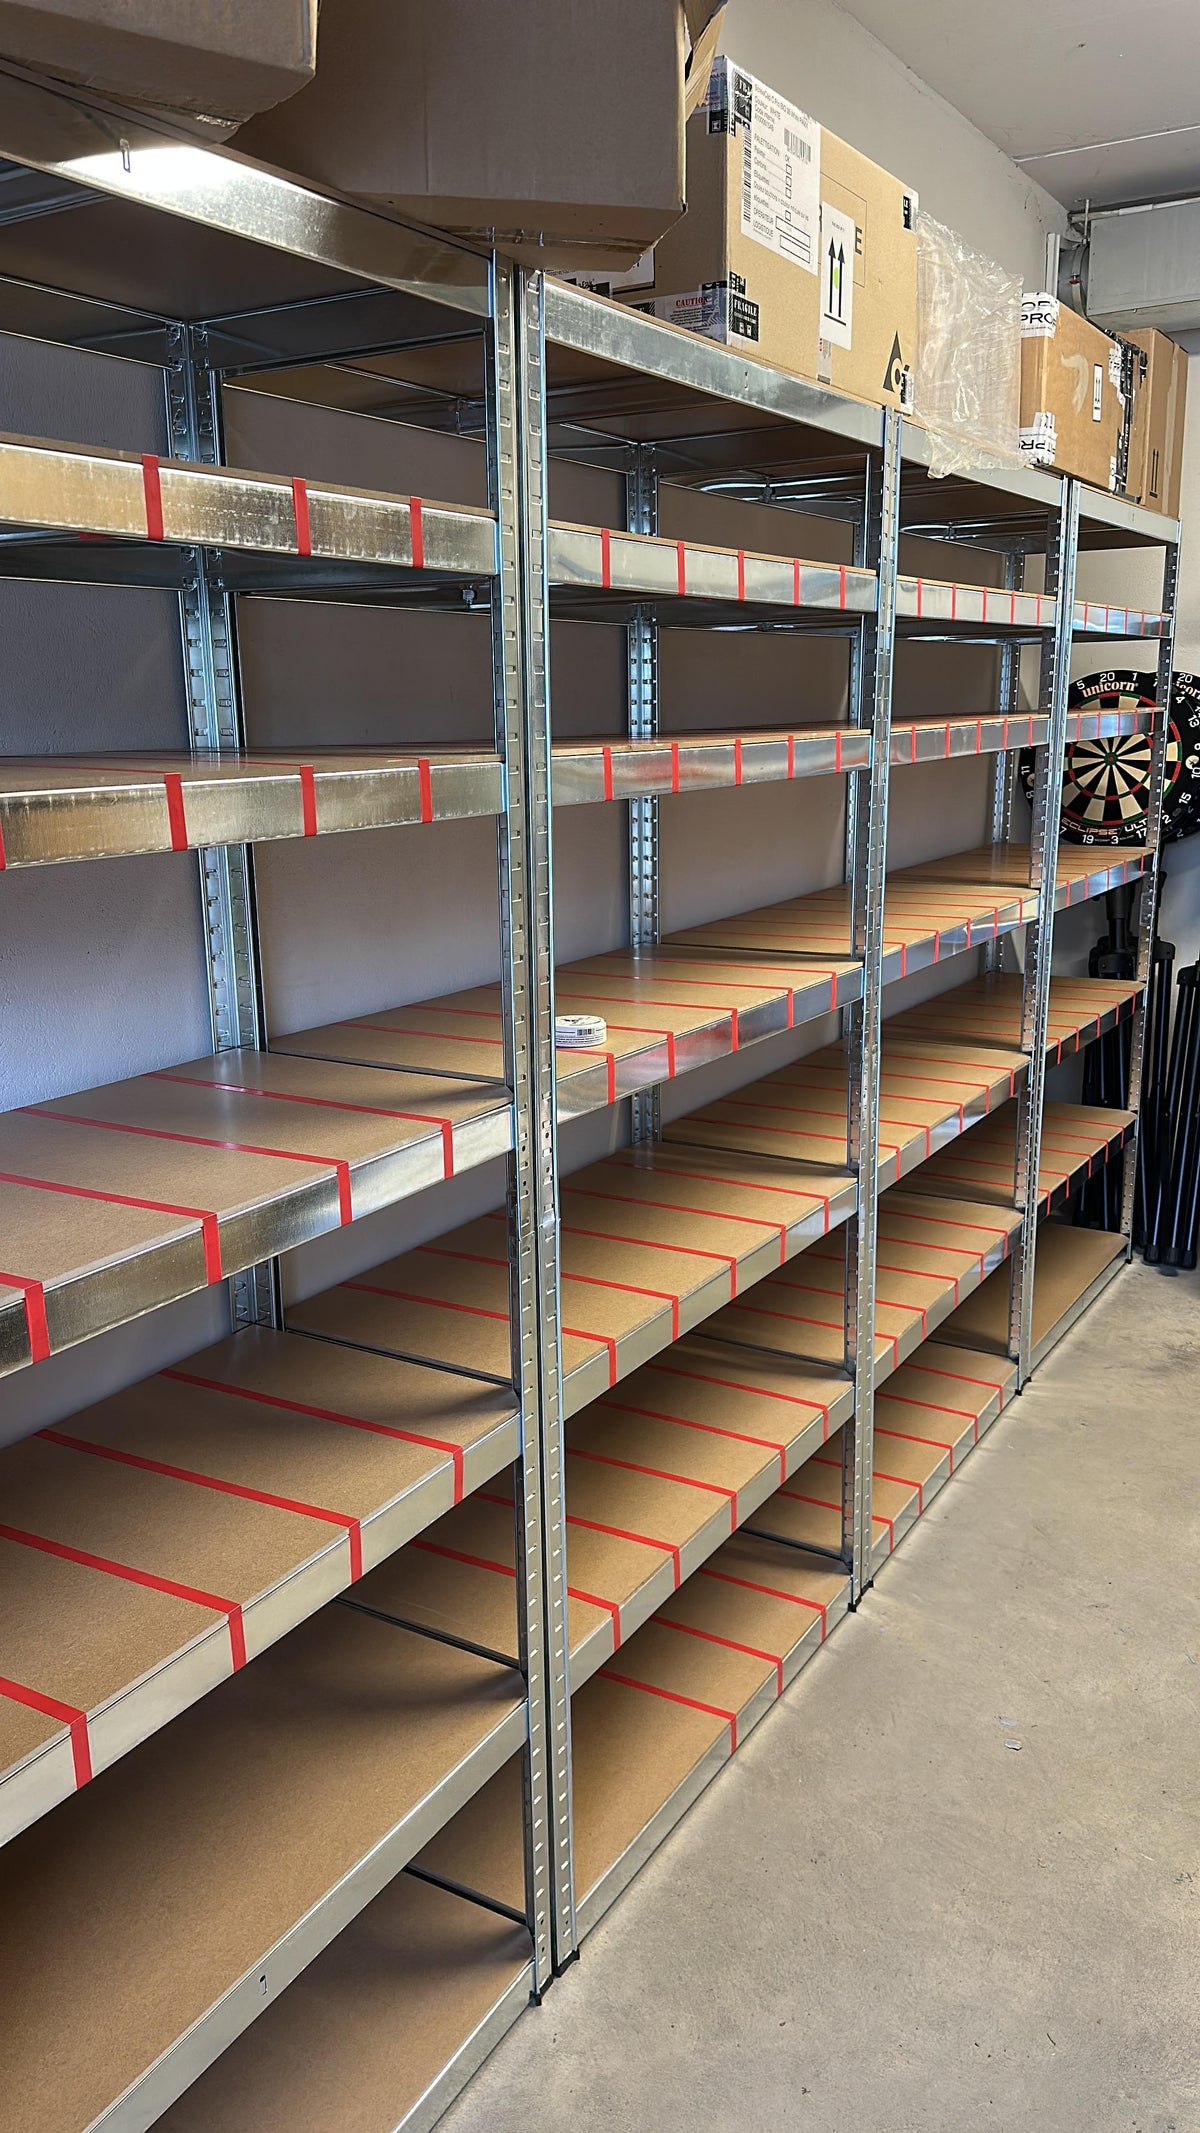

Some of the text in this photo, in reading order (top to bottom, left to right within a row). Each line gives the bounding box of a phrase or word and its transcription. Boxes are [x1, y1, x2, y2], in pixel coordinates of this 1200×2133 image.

[855, 227, 862, 255] E
[734, 299, 757, 317] FRAGILE
[1100, 672, 1115, 682] 20
[1132, 672, 1138, 681] 1
[1178, 672, 1193, 684] 20
[1077, 680, 1085, 690] 5
[1082, 680, 1136, 698] unicorn
[1175, 696, 1185, 704] 4
[1188, 714, 1200, 728] 13
[1021, 765, 1030, 776] 11
[1178, 792, 1191, 804] 15
[1162, 814, 1172, 825] 2
[1061, 817, 1148, 836] ECLIPSE ULT
[1136, 827, 1147, 839] 17
[1082, 834, 1094, 844] 19
[1110, 835, 1119, 844] 3
